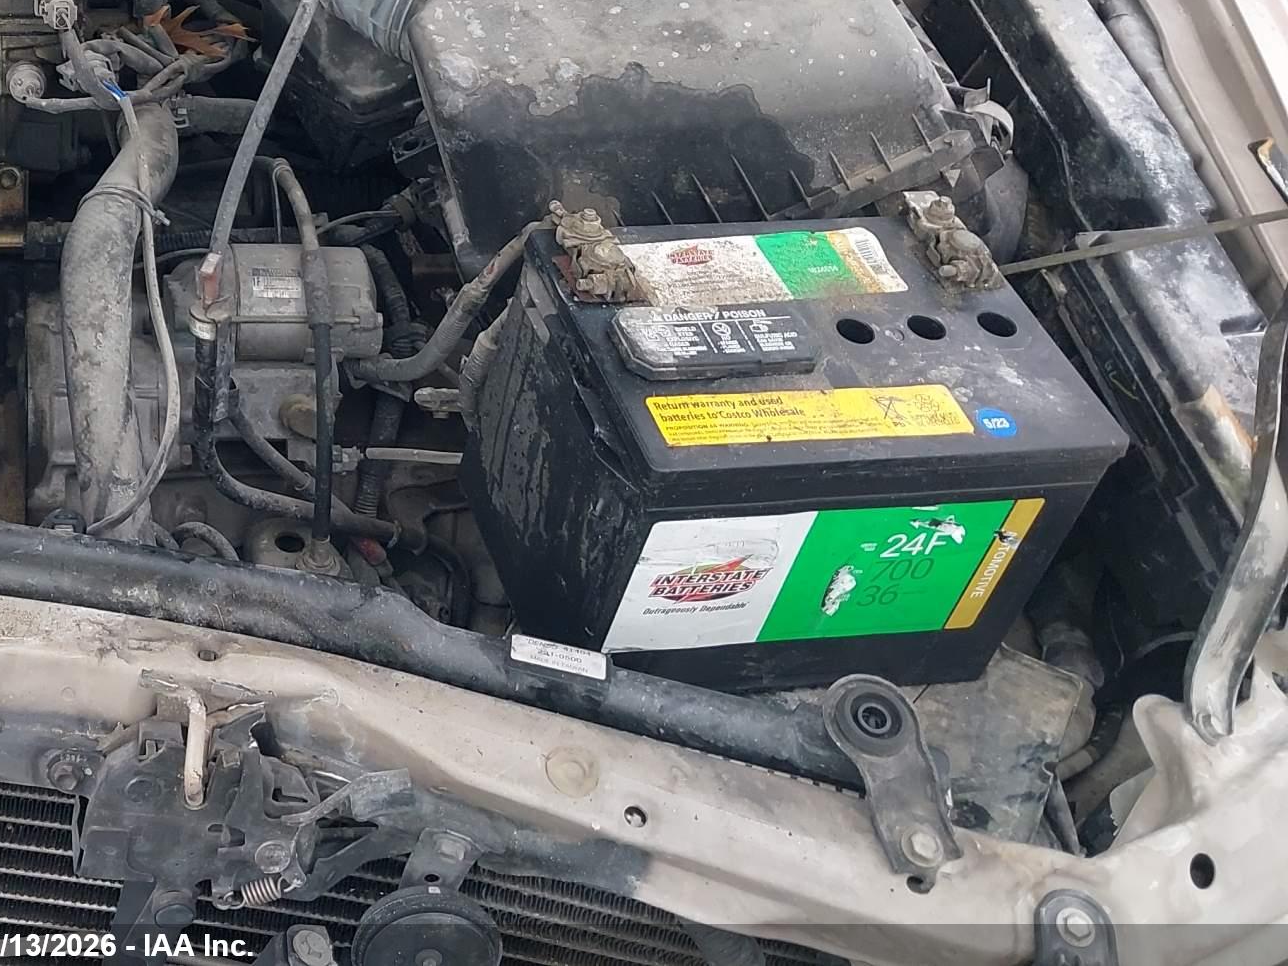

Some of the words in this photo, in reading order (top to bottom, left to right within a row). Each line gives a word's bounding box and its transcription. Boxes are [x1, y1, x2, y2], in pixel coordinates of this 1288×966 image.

[663, 312, 711, 322] DANGER
[723, 309, 766, 319] POISON
[653, 400, 689, 411] Return
[689, 399, 736, 410] warranty
[736, 397, 757, 407] and
[758, 395, 784, 406] used
[659, 410, 706, 423] batteries
[708, 410, 718, 420] to
[718, 409, 752, 420] Costco
[752, 406, 805, 418] Wholesale
[879, 531, 947, 558] 24F
[654, 569, 765, 586] INTERSTATE
[869, 557, 934, 584] 700
[653, 581, 753, 596] BATTERIES
[856, 584, 900, 607] 36
[642, 605, 699, 616] Outrageously
[699, 601, 747, 614] Dependable
